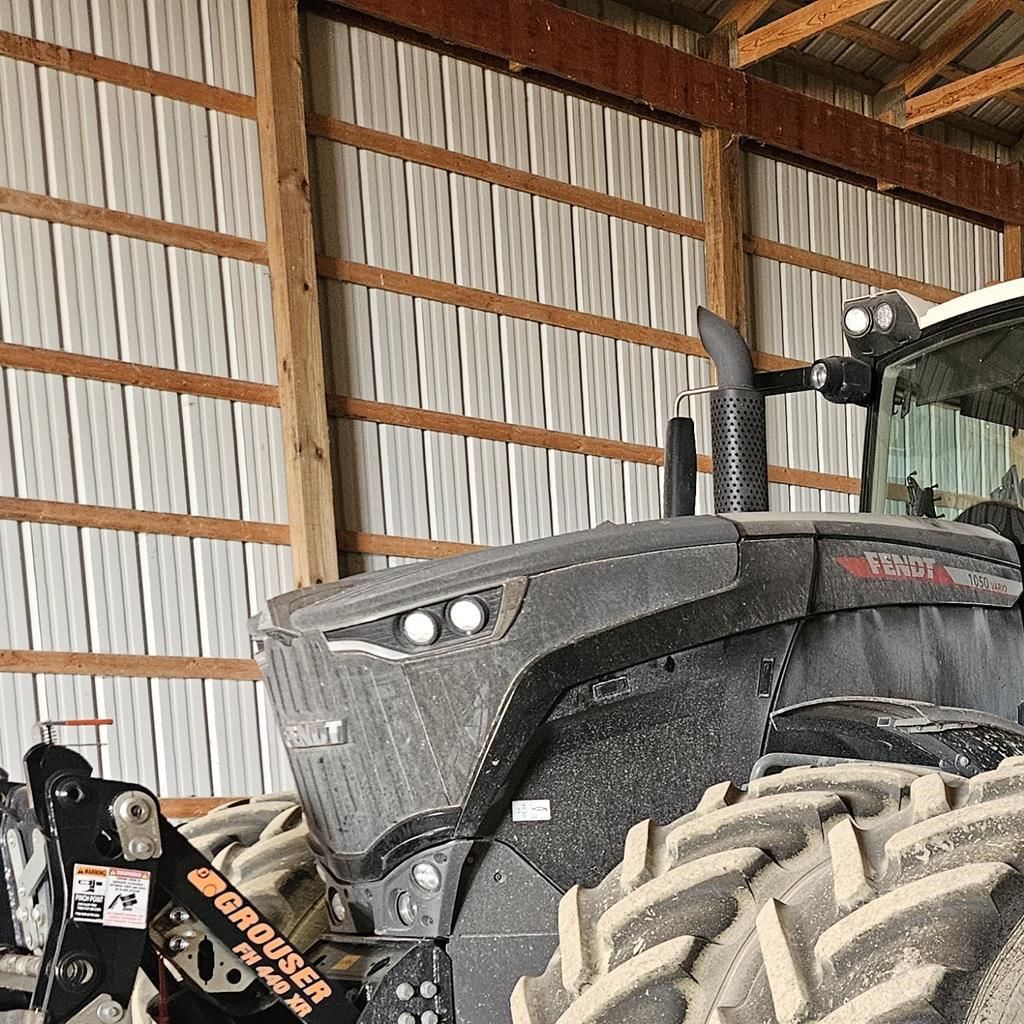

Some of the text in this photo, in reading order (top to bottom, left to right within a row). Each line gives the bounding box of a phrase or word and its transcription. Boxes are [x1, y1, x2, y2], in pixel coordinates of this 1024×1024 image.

[864, 552, 935, 579] FENDT
[968, 573, 990, 589] 1050
[214, 891, 332, 1004] GROUSER
[231, 941, 313, 1018] FH 440 XR
